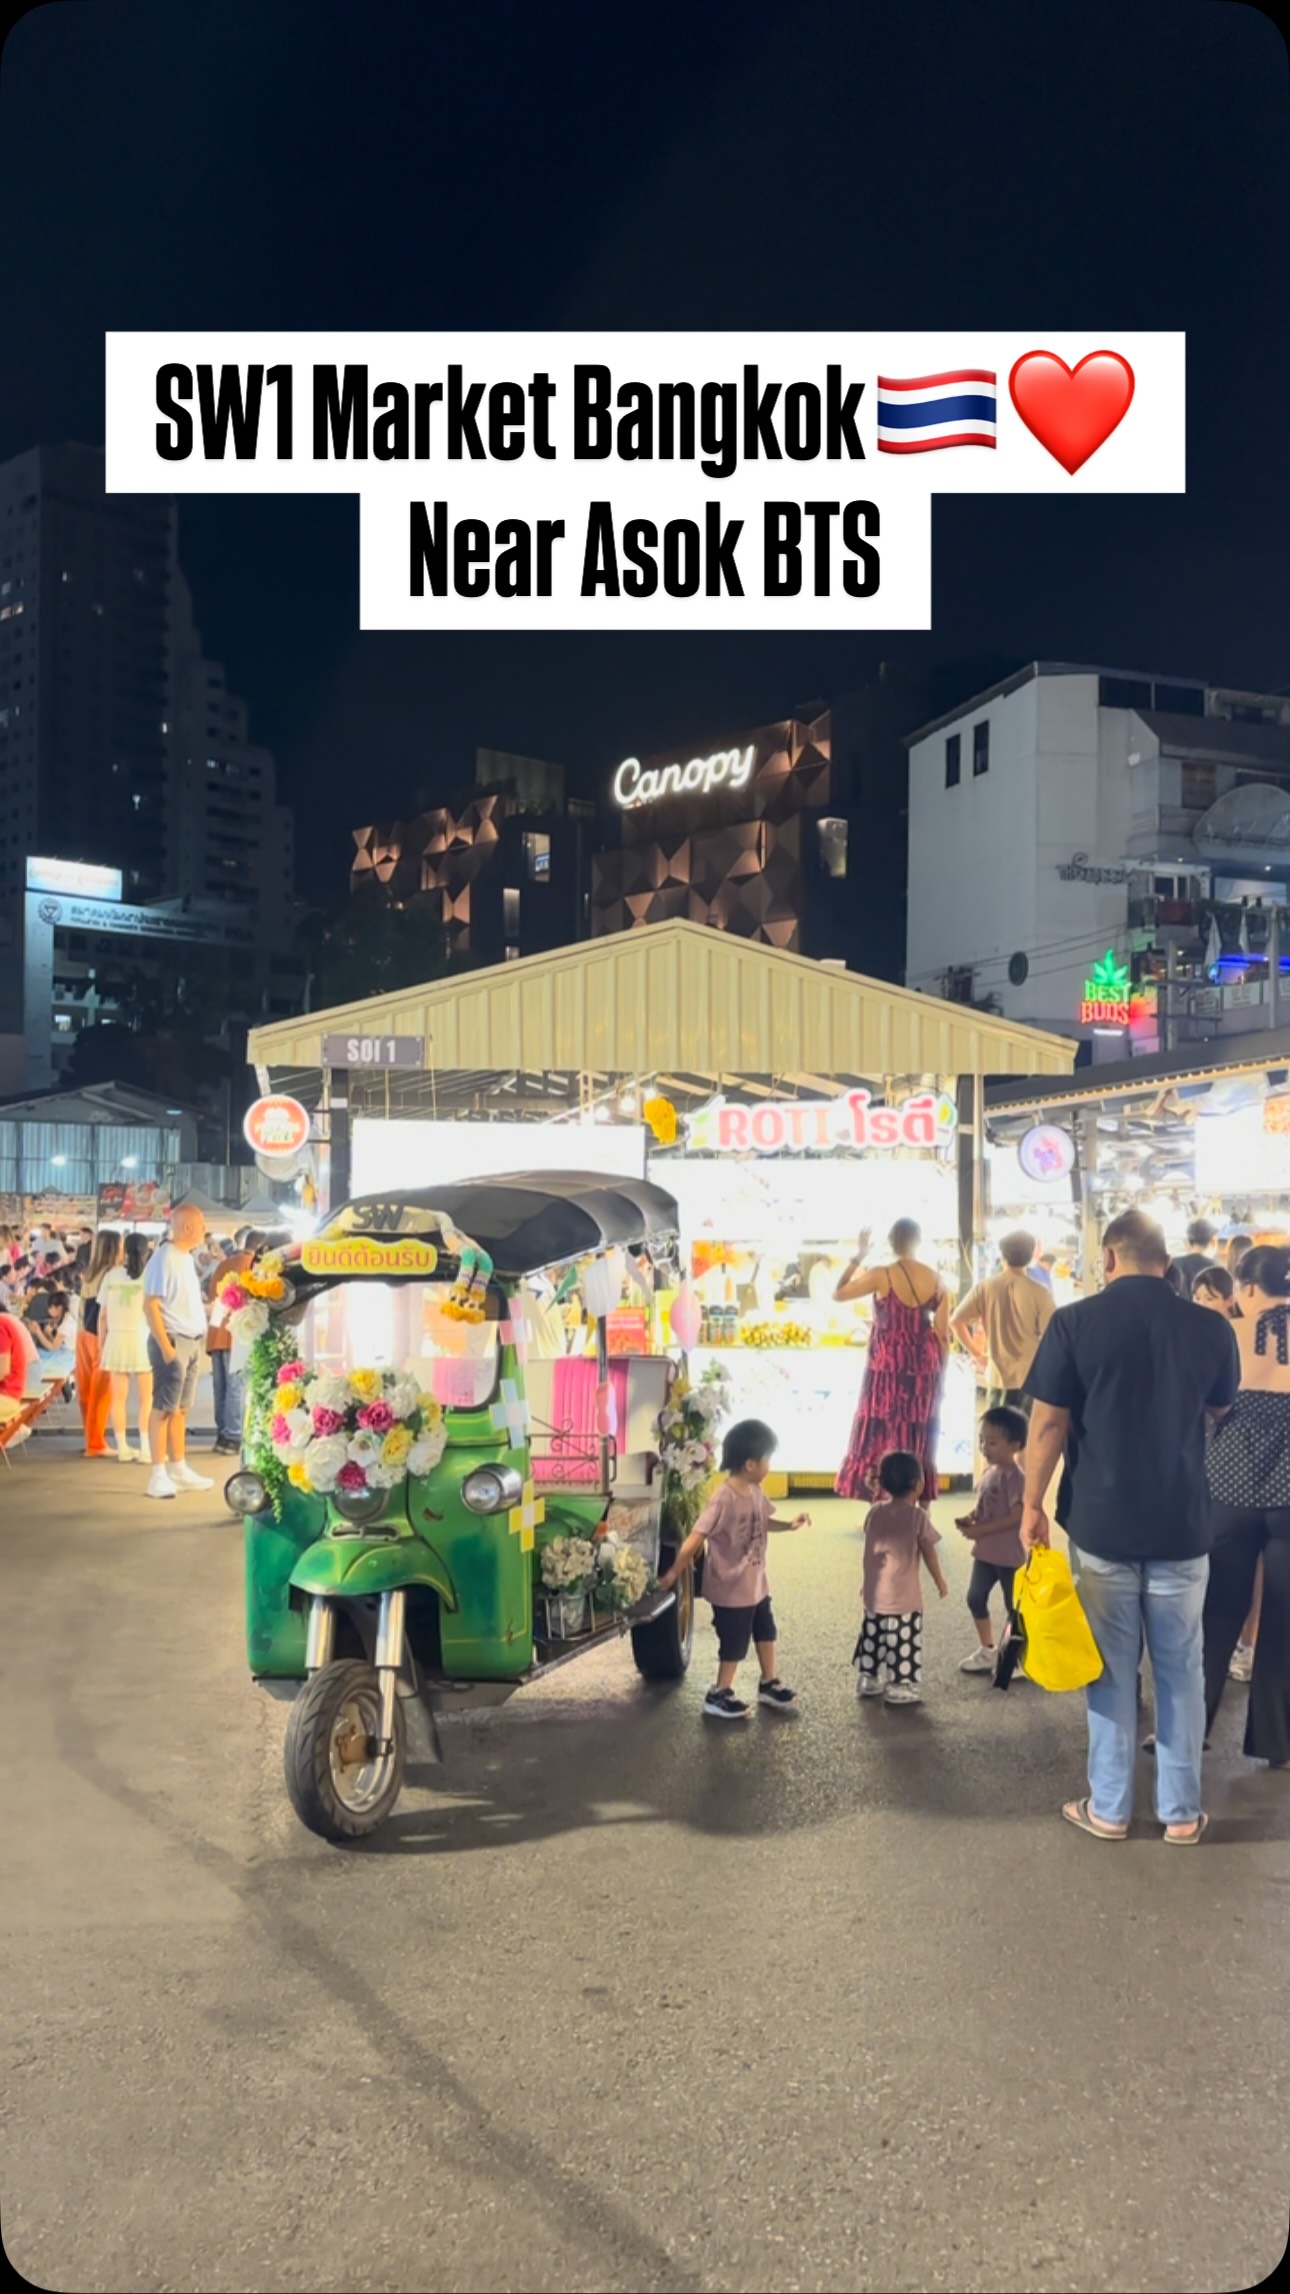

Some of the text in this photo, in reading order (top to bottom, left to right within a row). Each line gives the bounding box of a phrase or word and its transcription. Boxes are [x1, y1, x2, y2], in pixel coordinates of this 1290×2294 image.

[614, 744, 755, 804] Canopy
[1084, 980, 1132, 1003] BEST
[1081, 1001, 1131, 1025] BUDS
[346, 1038, 396, 1063] SOI 1
[717, 1107, 831, 1147] ROTI
[308, 1242, 431, 1268] ยินดีต้อนรับ
